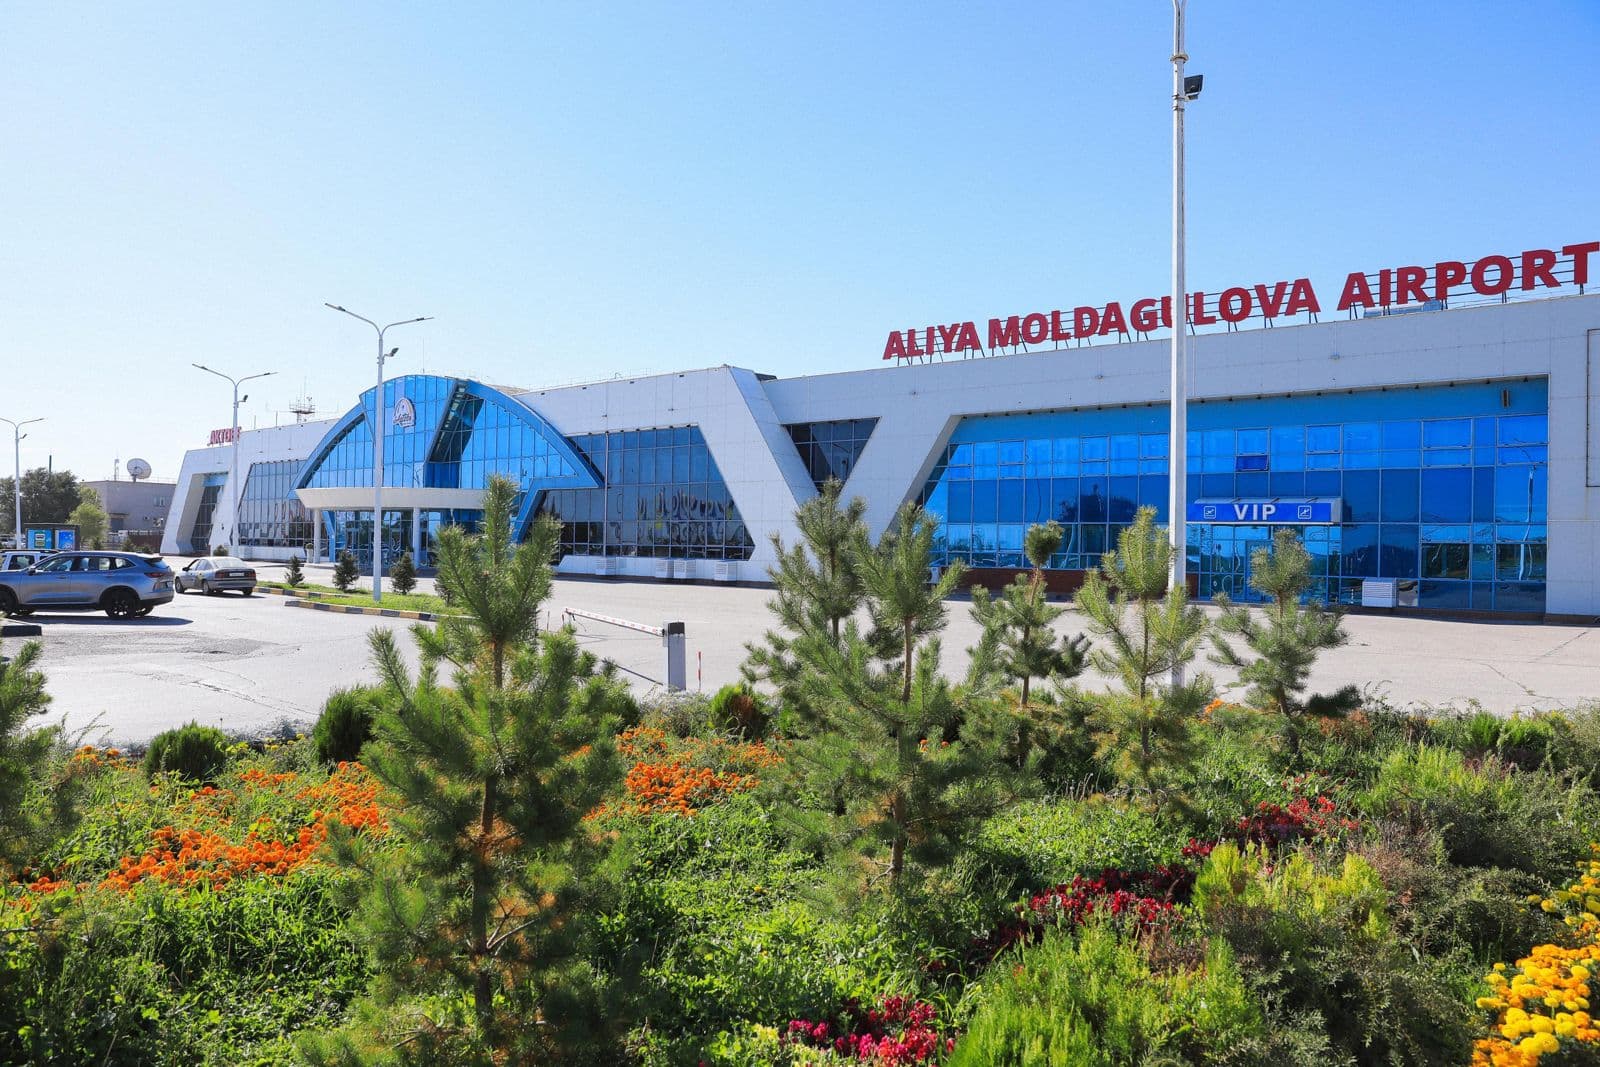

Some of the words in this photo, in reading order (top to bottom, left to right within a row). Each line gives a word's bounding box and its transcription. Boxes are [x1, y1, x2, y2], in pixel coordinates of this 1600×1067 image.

[883, 322, 981, 360] ALIYA
[988, 278, 1321, 349] MOLDAGULOVA
[1337, 241, 1600, 311] AIRPORT
[1234, 503, 1276, 521] VIP
